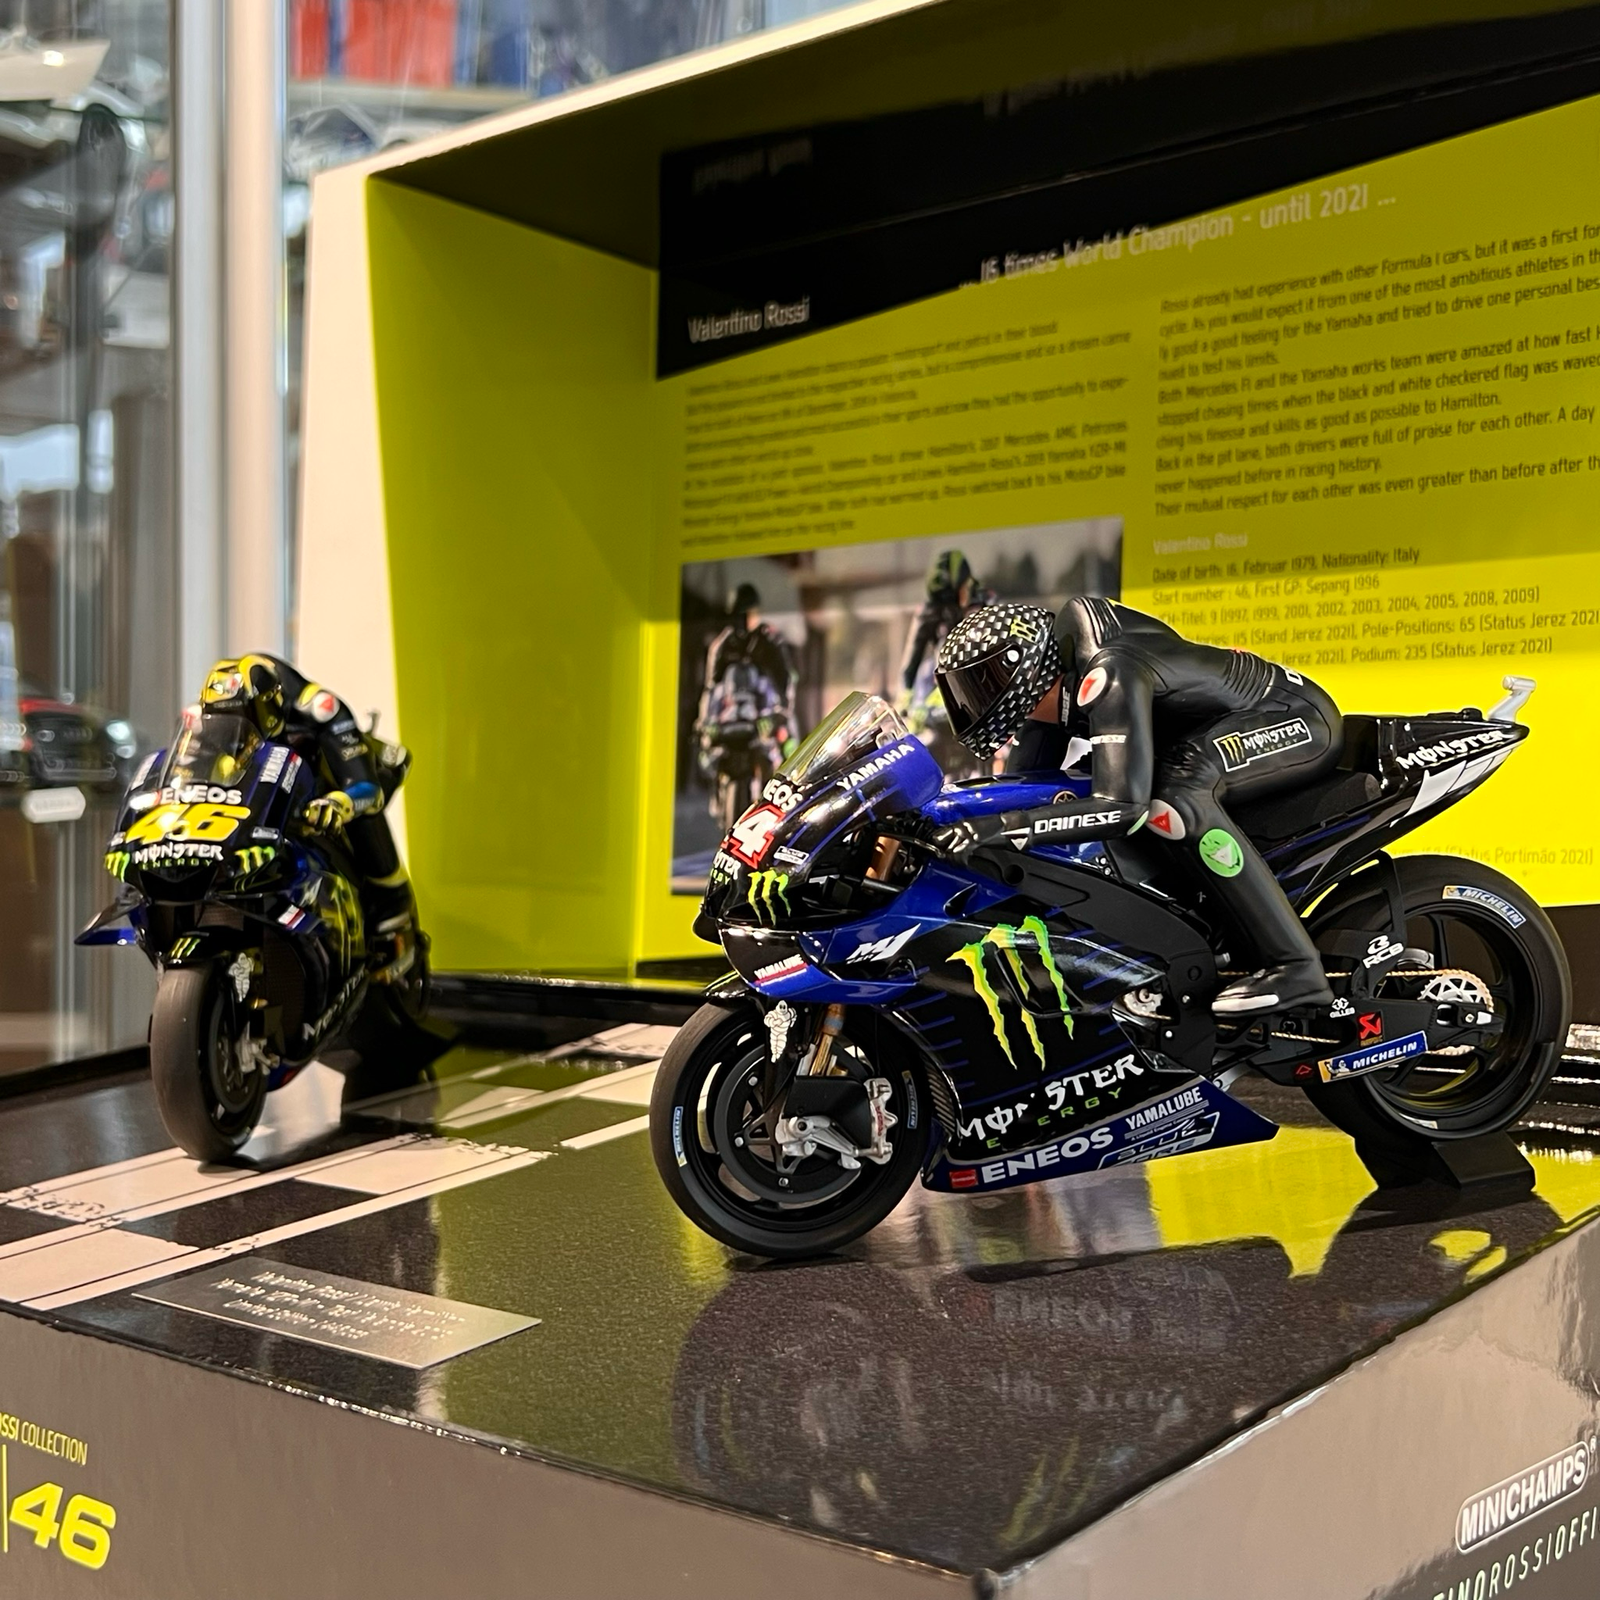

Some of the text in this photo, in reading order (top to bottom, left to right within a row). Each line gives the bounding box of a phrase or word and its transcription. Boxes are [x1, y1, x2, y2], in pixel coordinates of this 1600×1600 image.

[1003, 249, 1059, 281] times
[1063, 228, 1123, 271] World
[1128, 212, 1233, 256] Champion
[1259, 194, 1311, 230] until
[1319, 183, 1368, 220] 2021
[1381, 254, 1432, 275] Formula
[1474, 241, 1495, 259] but
[1512, 237, 1536, 252] was
[1552, 226, 1577, 245] first
[1350, 290, 1371, 305] one
[1391, 282, 1410, 298] the
[1414, 274, 1444, 294] most
[1449, 266, 1511, 288] ambitious
[1515, 256, 1568, 277] athletes
[687, 296, 810, 344] Valentino Rossi
[1303, 320, 1321, 336] the
[1325, 313, 1372, 332] Yamaha
[1376, 307, 1398, 325] and
[1402, 301, 1430, 320] tried
[1451, 295, 1482, 312] drive
[1487, 291, 1510, 307] one
[1514, 278, 1571, 306] personal
[1279, 372, 1296, 386] the
[1301, 365, 1348, 383] Yamaha
[1352, 358, 1386, 376] works
[1390, 354, 1420, 370] team
[1425, 349, 1456, 365] were
[1460, 339, 1511, 360] amazed
[1534, 334, 1560, 349] how
[1565, 326, 1590, 345] fast
[1316, 360, 1558, 405] the black and white checkered flag was
[1265, 442, 1290, 459] both
[1339, 434, 1368, 449] were
[1373, 428, 1392, 445] full
[1413, 423, 1452, 444] praise
[1457, 419, 1474, 435] for
[1480, 414, 1510, 432] each
[1514, 411, 1552, 428] other.
[1571, 405, 1594, 424] day
[1321, 410, 1348, 433] good
[1370, 402, 1420, 426] possible
[1440, 392, 1501, 412] Hamilton.
[1292, 457, 1582, 503] each other was even greater than before after
[1299, 462, 1334, 480] racing
[1152, 567, 1177, 583] Date
[1243, 559, 1286, 575] Februar
[1322, 549, 1388, 569] Nationality:
[1392, 546, 1419, 565] Italy
[1153, 532, 1248, 556] Valentino Rossi
[1153, 574, 1379, 605] Start number First Sepang 1996
[1315, 600, 1346, 618] 2002,
[1352, 598, 1382, 616] 2003,
[1388, 596, 1420, 613] 2004,
[1424, 592, 1458, 610] 2005,
[1464, 590, 1498, 608] 2008,
[1502, 585, 1539, 605] 2009)
[1250, 628, 1288, 645] (Stand
[1291, 627, 1321, 643] Jerez
[1362, 619, 1454, 638] Pole-Positions:
[1479, 614, 1526, 632] (Status
[1529, 612, 1565, 629] Jerez
[1350, 646, 1400, 663] Podium:
[1404, 643, 1426, 661] 235
[1431, 641, 1476, 659] (Status
[1480, 640, 1514, 657] Jerez
[1519, 635, 1552, 655] 2021)
[1242, 722, 1306, 751] MONSTER
[1396, 730, 1514, 769] MONSTER
[837, 743, 915, 791] YAMAHA
[161, 785, 242, 805] ENEOS
[126, 803, 251, 845] 46
[1034, 810, 1122, 834] DAINESE
[134, 842, 224, 864] MONSTER
[142, 859, 213, 870] ENERGY
[1494, 846, 1555, 865] Portimão
[1462, 889, 1522, 923] MICHELIN
[1363, 943, 1404, 968] RCB
[1353, 1041, 1417, 1069] MICHELIN
[986, 1087, 1122, 1149] EERGY
[1125, 1086, 1203, 1130] YAMALUBE
[981, 1127, 1113, 1184] ENEOS
[21, 1421, 88, 1466] COLLECTION
[1461, 1448, 1585, 1545] MINICHAMPS
[9, 1482, 116, 1570] 46
